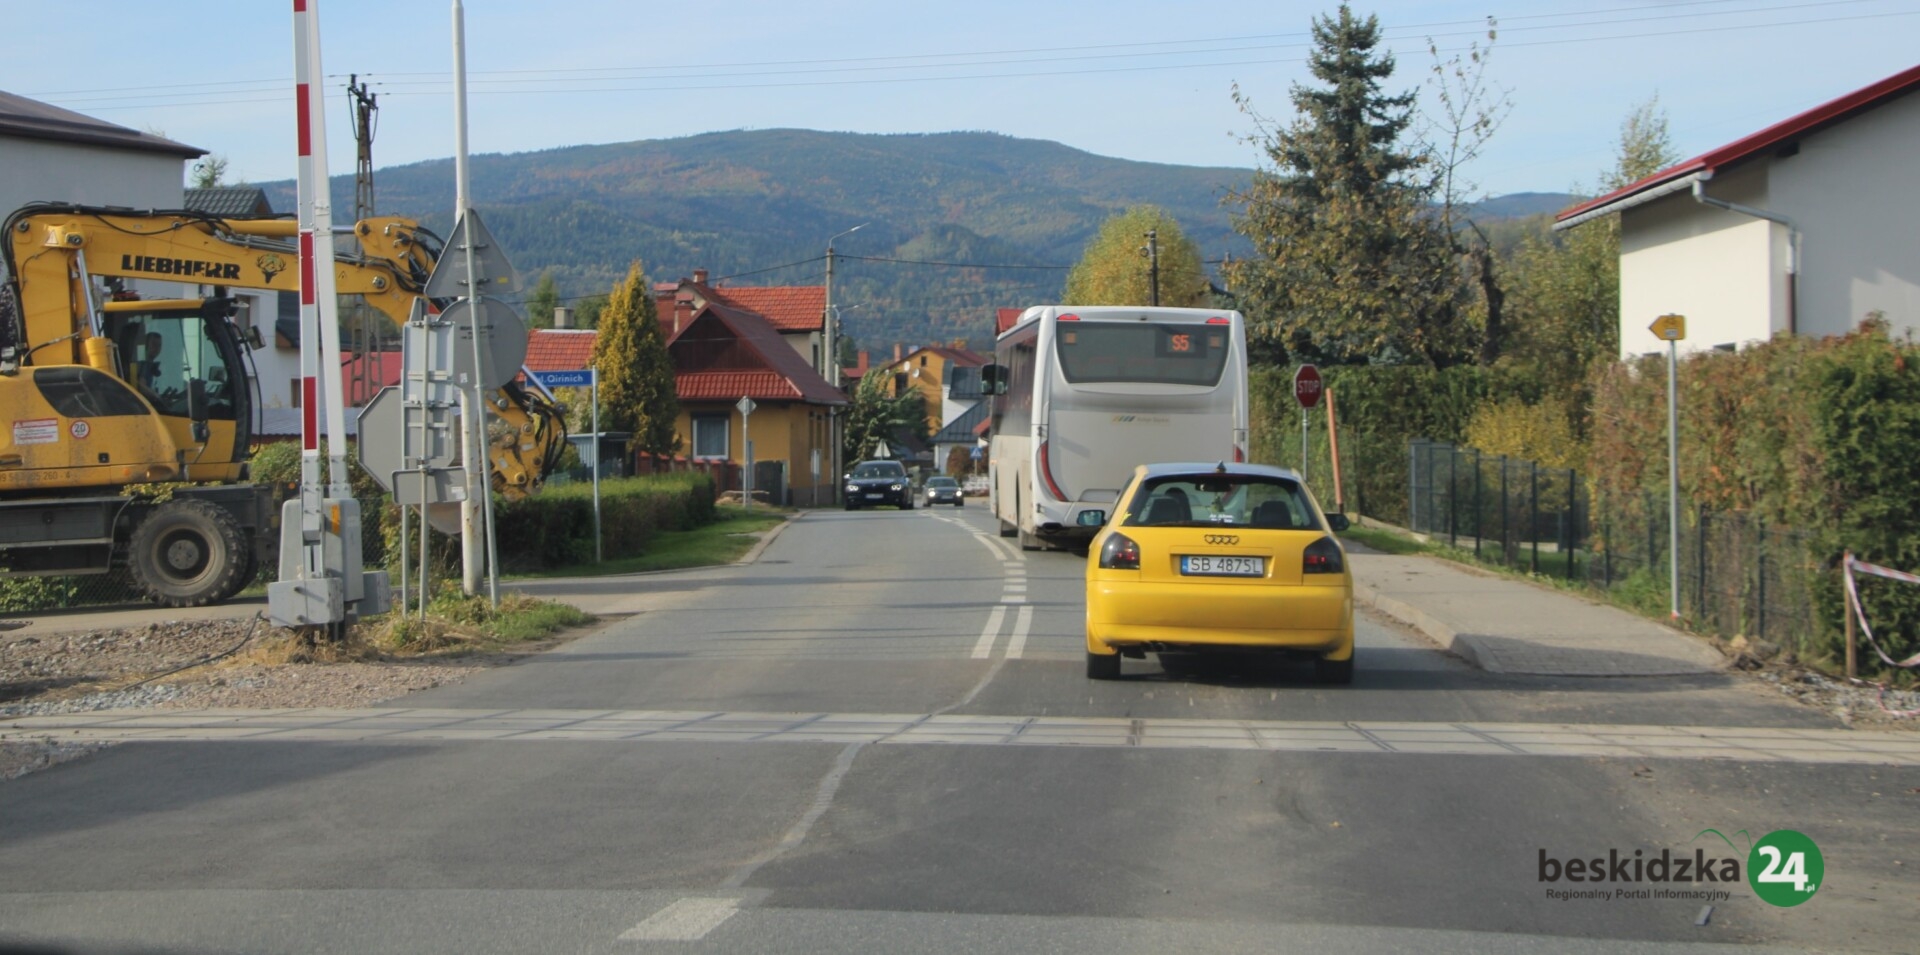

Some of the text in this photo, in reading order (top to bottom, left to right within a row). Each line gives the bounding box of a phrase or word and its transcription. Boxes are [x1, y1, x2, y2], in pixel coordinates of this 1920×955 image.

[1172, 335, 1190, 351] S5
[1298, 380, 1319, 394] STOP
[75, 423, 86, 433] 20
[1191, 557, 1261, 573] SB 4875L
